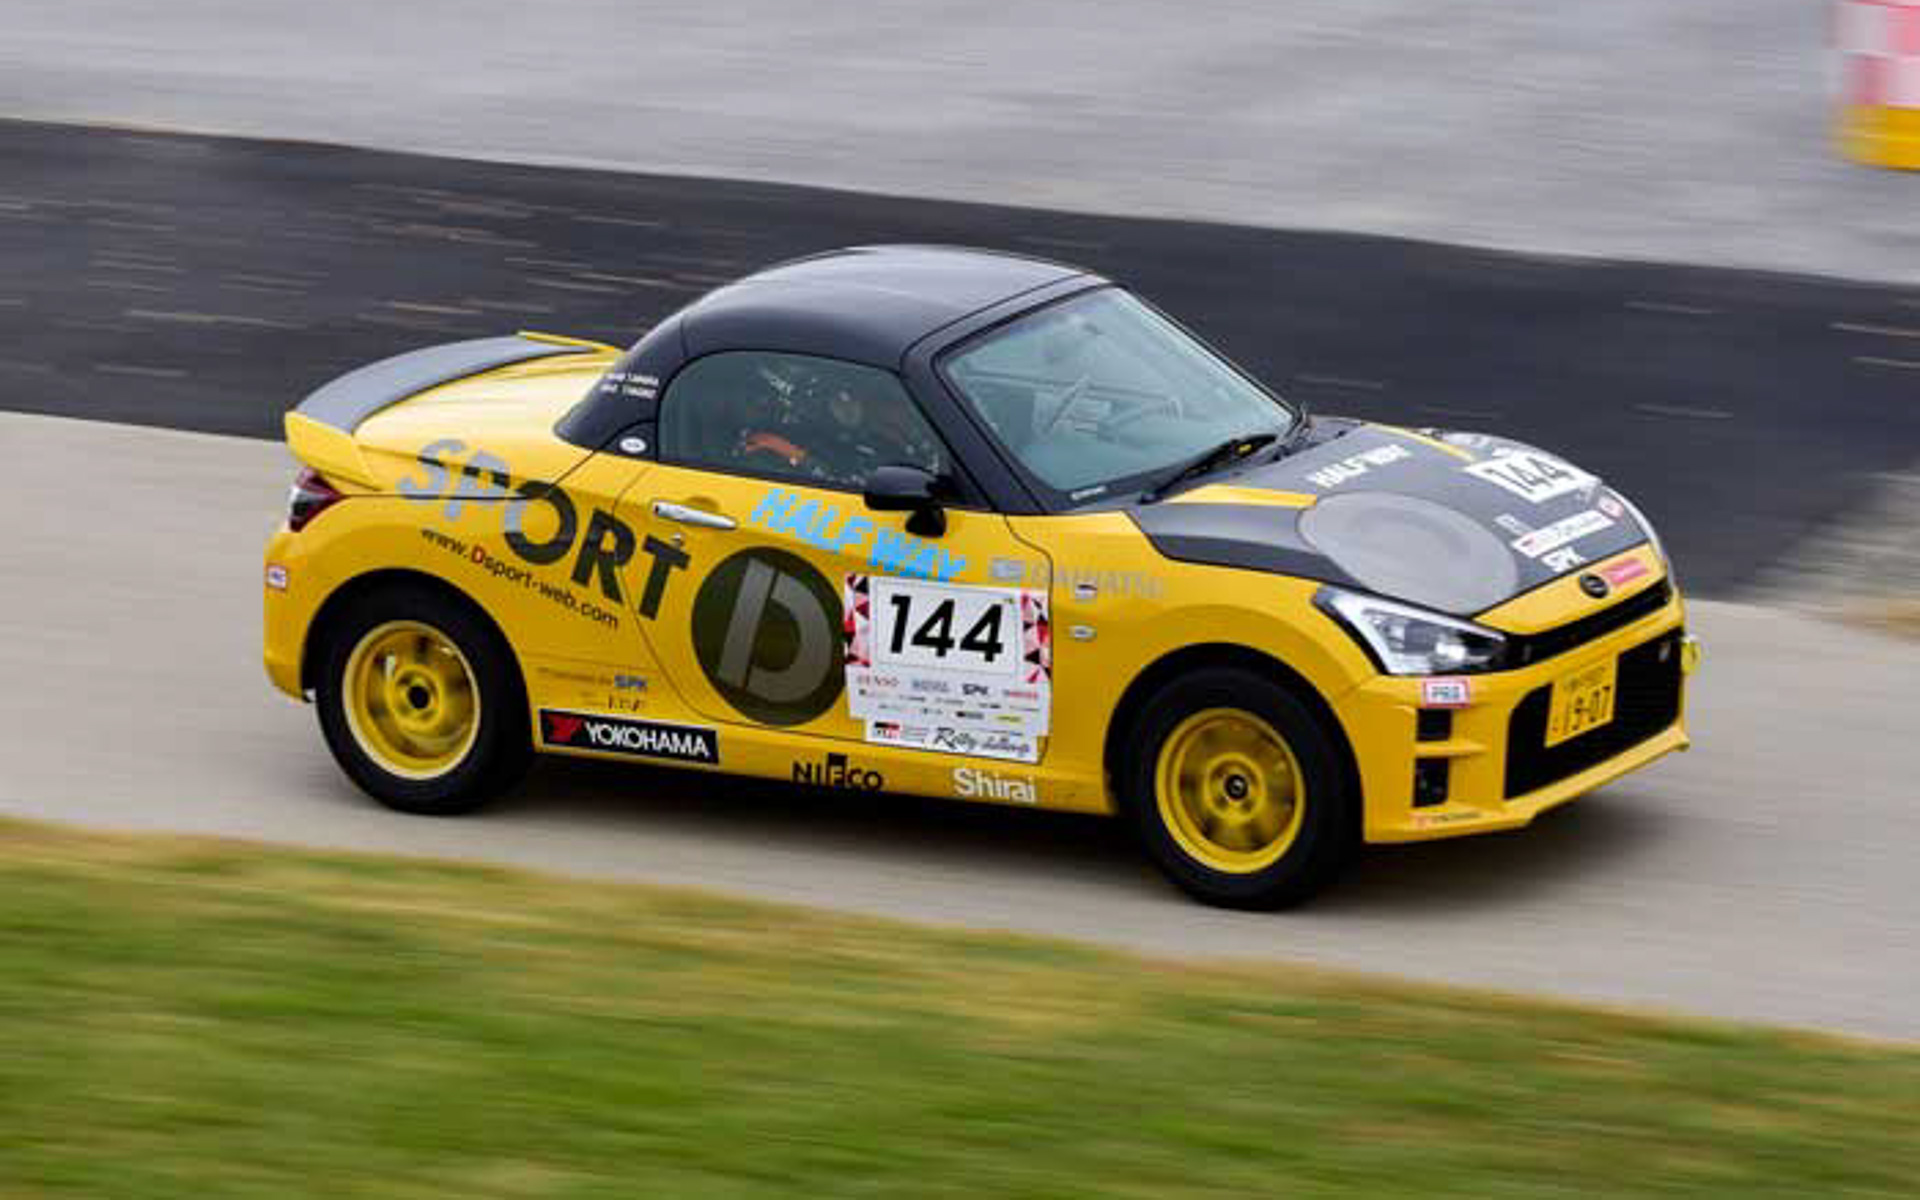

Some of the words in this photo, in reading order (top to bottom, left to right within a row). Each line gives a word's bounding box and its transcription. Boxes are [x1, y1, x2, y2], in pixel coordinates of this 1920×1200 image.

[1483, 456, 1578, 495] 144
[396, 437, 691, 621] SPORT
[889, 594, 1004, 663] 144
[585, 721, 711, 759] YOKOHAMA
[952, 767, 1038, 803] Shirai
